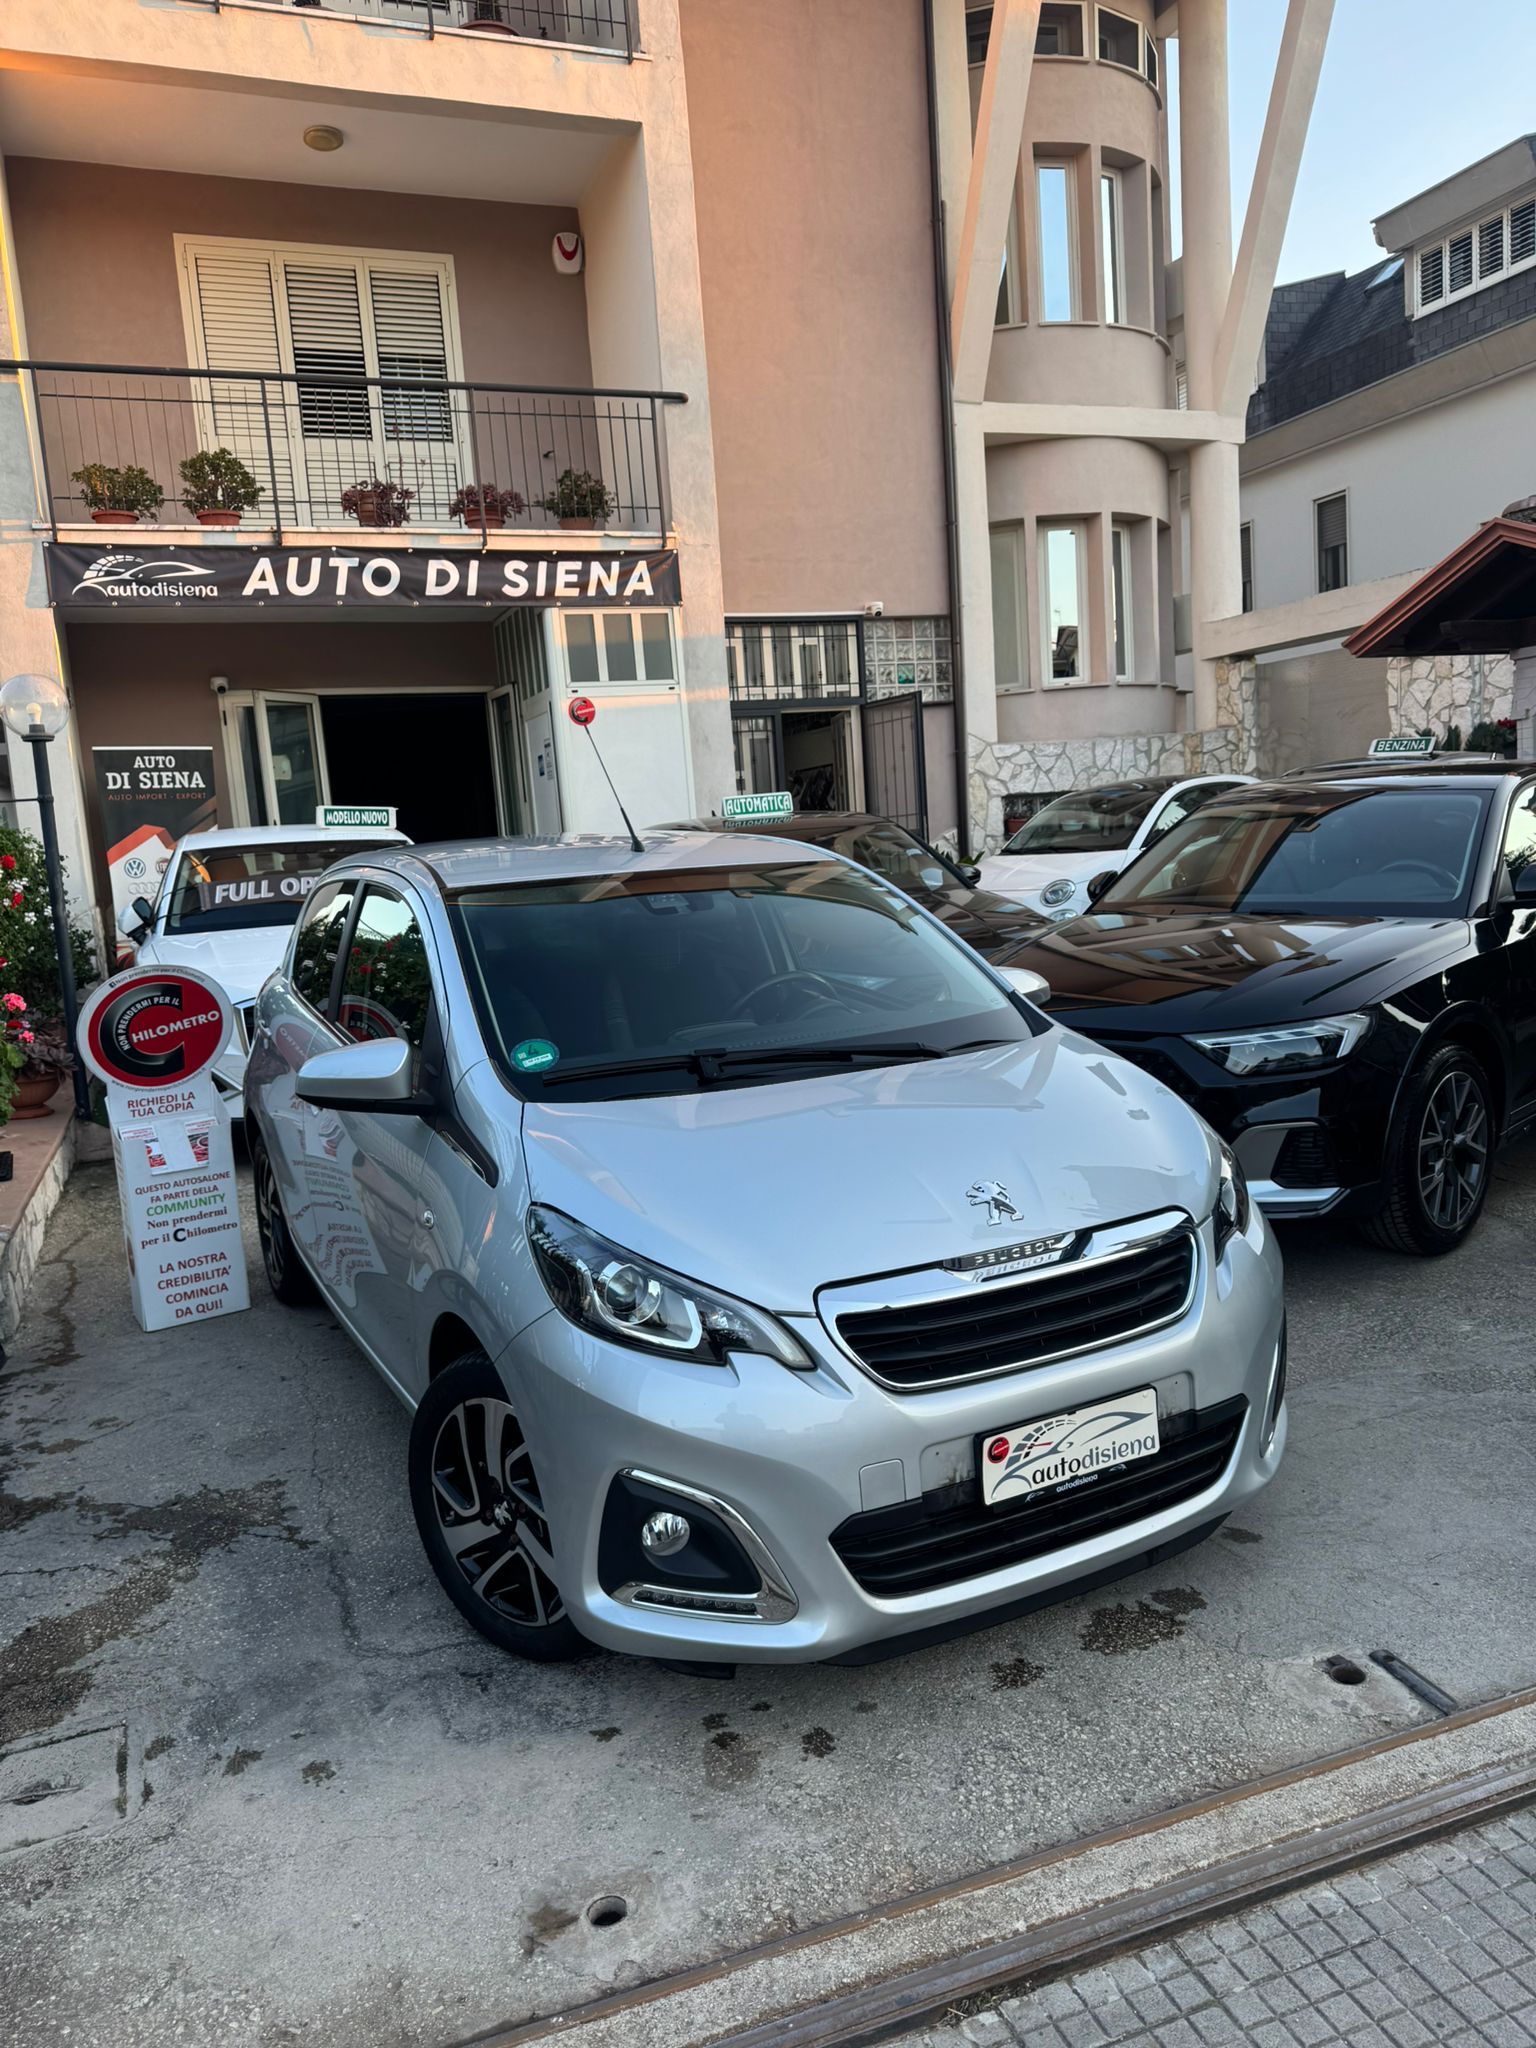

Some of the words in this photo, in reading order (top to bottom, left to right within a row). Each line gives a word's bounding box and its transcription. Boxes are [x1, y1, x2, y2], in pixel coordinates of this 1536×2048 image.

[241, 557, 401, 597] AUTO
[425, 560, 479, 597] DI
[501, 560, 655, 597] SIENA
[106, 582, 218, 598] autodisiena
[1377, 740, 1426, 751] BENZINA
[133, 756, 176, 768] AUTO
[105, 772, 131, 789] DI
[138, 771, 206, 789] SIENA
[726, 795, 791, 815] AUTOMATICA
[326, 810, 360, 824] MODELLO
[361, 811, 388, 824] NUOVO
[215, 879, 275, 904] FULL
[280, 876, 320, 896] OP
[153, 996, 170, 1004] PER
[171, 998, 180, 1006] IL
[117, 998, 152, 1034] PRENDERMI
[118, 1035, 131, 1050] NON
[127, 1094, 178, 1109] RICHIEDI
[181, 1091, 196, 1101] LA
[130, 1106, 155, 1118] TUA
[158, 1101, 194, 1114] COPIA
[135, 1182, 171, 1195] QUESTO
[172, 1171, 231, 1188] AUTOSALONE
[150, 1195, 162, 1204] FA
[163, 1190, 190, 1201] PARTE
[192, 1184, 219, 1196] DELLA
[146, 1193, 226, 1217] COMMUNITY
[147, 1219, 169, 1230] Non
[172, 1206, 228, 1227] prendermi
[141, 1238, 160, 1249] per
[162, 1233, 170, 1243] il
[173, 1221, 238, 1243] Chilometro
[974, 1239, 1056, 1265] PEUGEOT
[159, 1262, 175, 1274] LA
[177, 1251, 228, 1270] NOSTRA
[157, 1265, 232, 1290] CREDIBILITA'
[165, 1282, 229, 1304] COMINCIA
[175, 1307, 193, 1319] DA
[195, 1299, 223, 1314] QUI!
[1032, 1435, 1156, 1485] autodisiena
[1056, 1473, 1099, 1493] autodisiena
